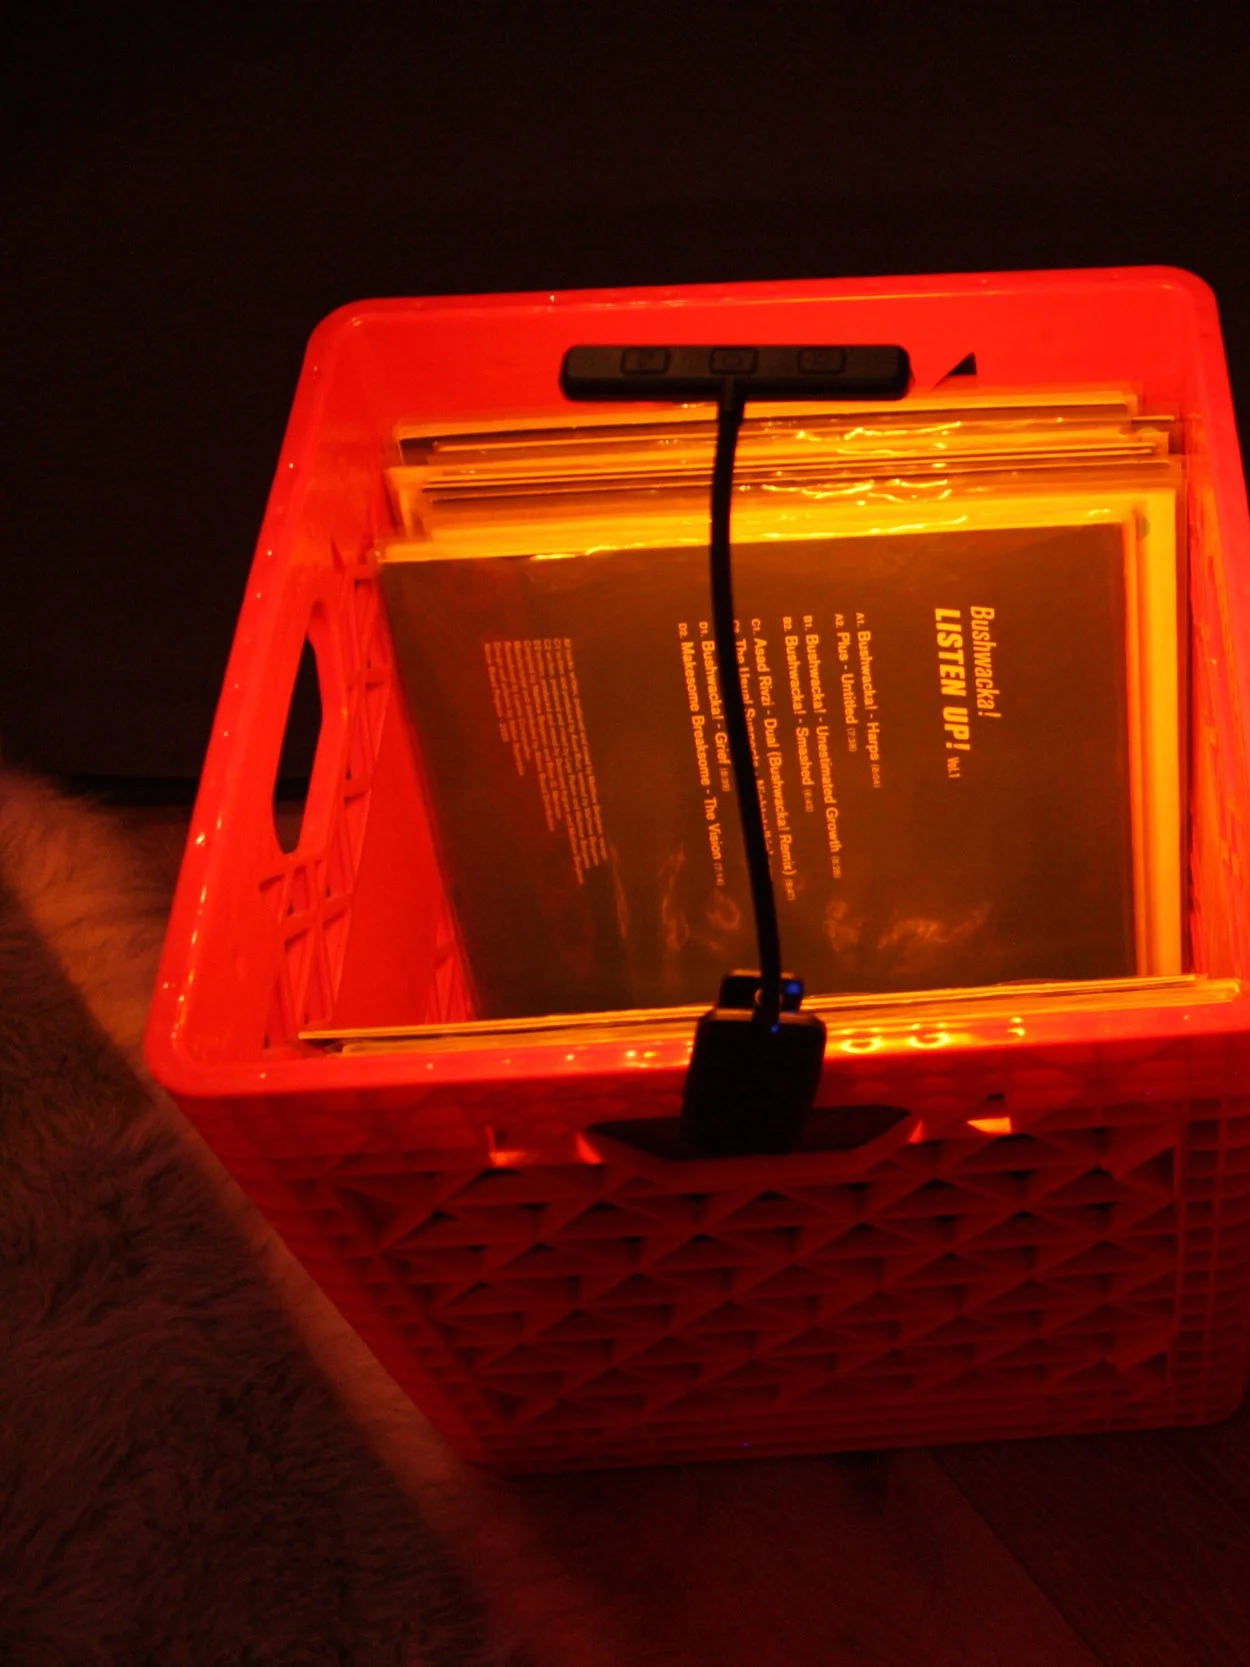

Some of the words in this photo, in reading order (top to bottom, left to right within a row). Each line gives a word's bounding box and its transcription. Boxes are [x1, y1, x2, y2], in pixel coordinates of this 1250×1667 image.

[698, 621, 709, 637] D1.
[751, 618, 761, 634] C1.
[802, 615, 813, 631] B1.
[855, 612, 865, 627] A1.
[753, 637, 771, 673] Asad
[836, 631, 851, 662] Plus
[934, 608, 967, 697] LISTEN
[969, 605, 1002, 718] Bushwacka!
[680, 641, 700, 712] Makesome
[701, 640, 725, 720] Bushwacka!
[758, 675, 775, 707] Rivzi
[784, 635, 807, 715] Bushwacka!
[805, 633, 827, 714] Bushwacka!
[857, 630, 878, 710] Bushwacka!
[840, 673, 859, 725] Untitled
[691, 714, 711, 786] Breaksome
[714, 731, 731, 765] Grief
[763, 718, 780, 748] Dual
[865, 721, 881, 761] Harps
[942, 706, 971, 751] UP!
[795, 726, 815, 786] Smashed
[815, 725, 837, 804] Unestimated
[703, 796, 718, 821] The
[766, 751, 791, 831] (Bushwacka!
[707, 822, 723, 860] Vision
[825, 806, 843, 853] Growth
[779, 833, 797, 876] Remix)
